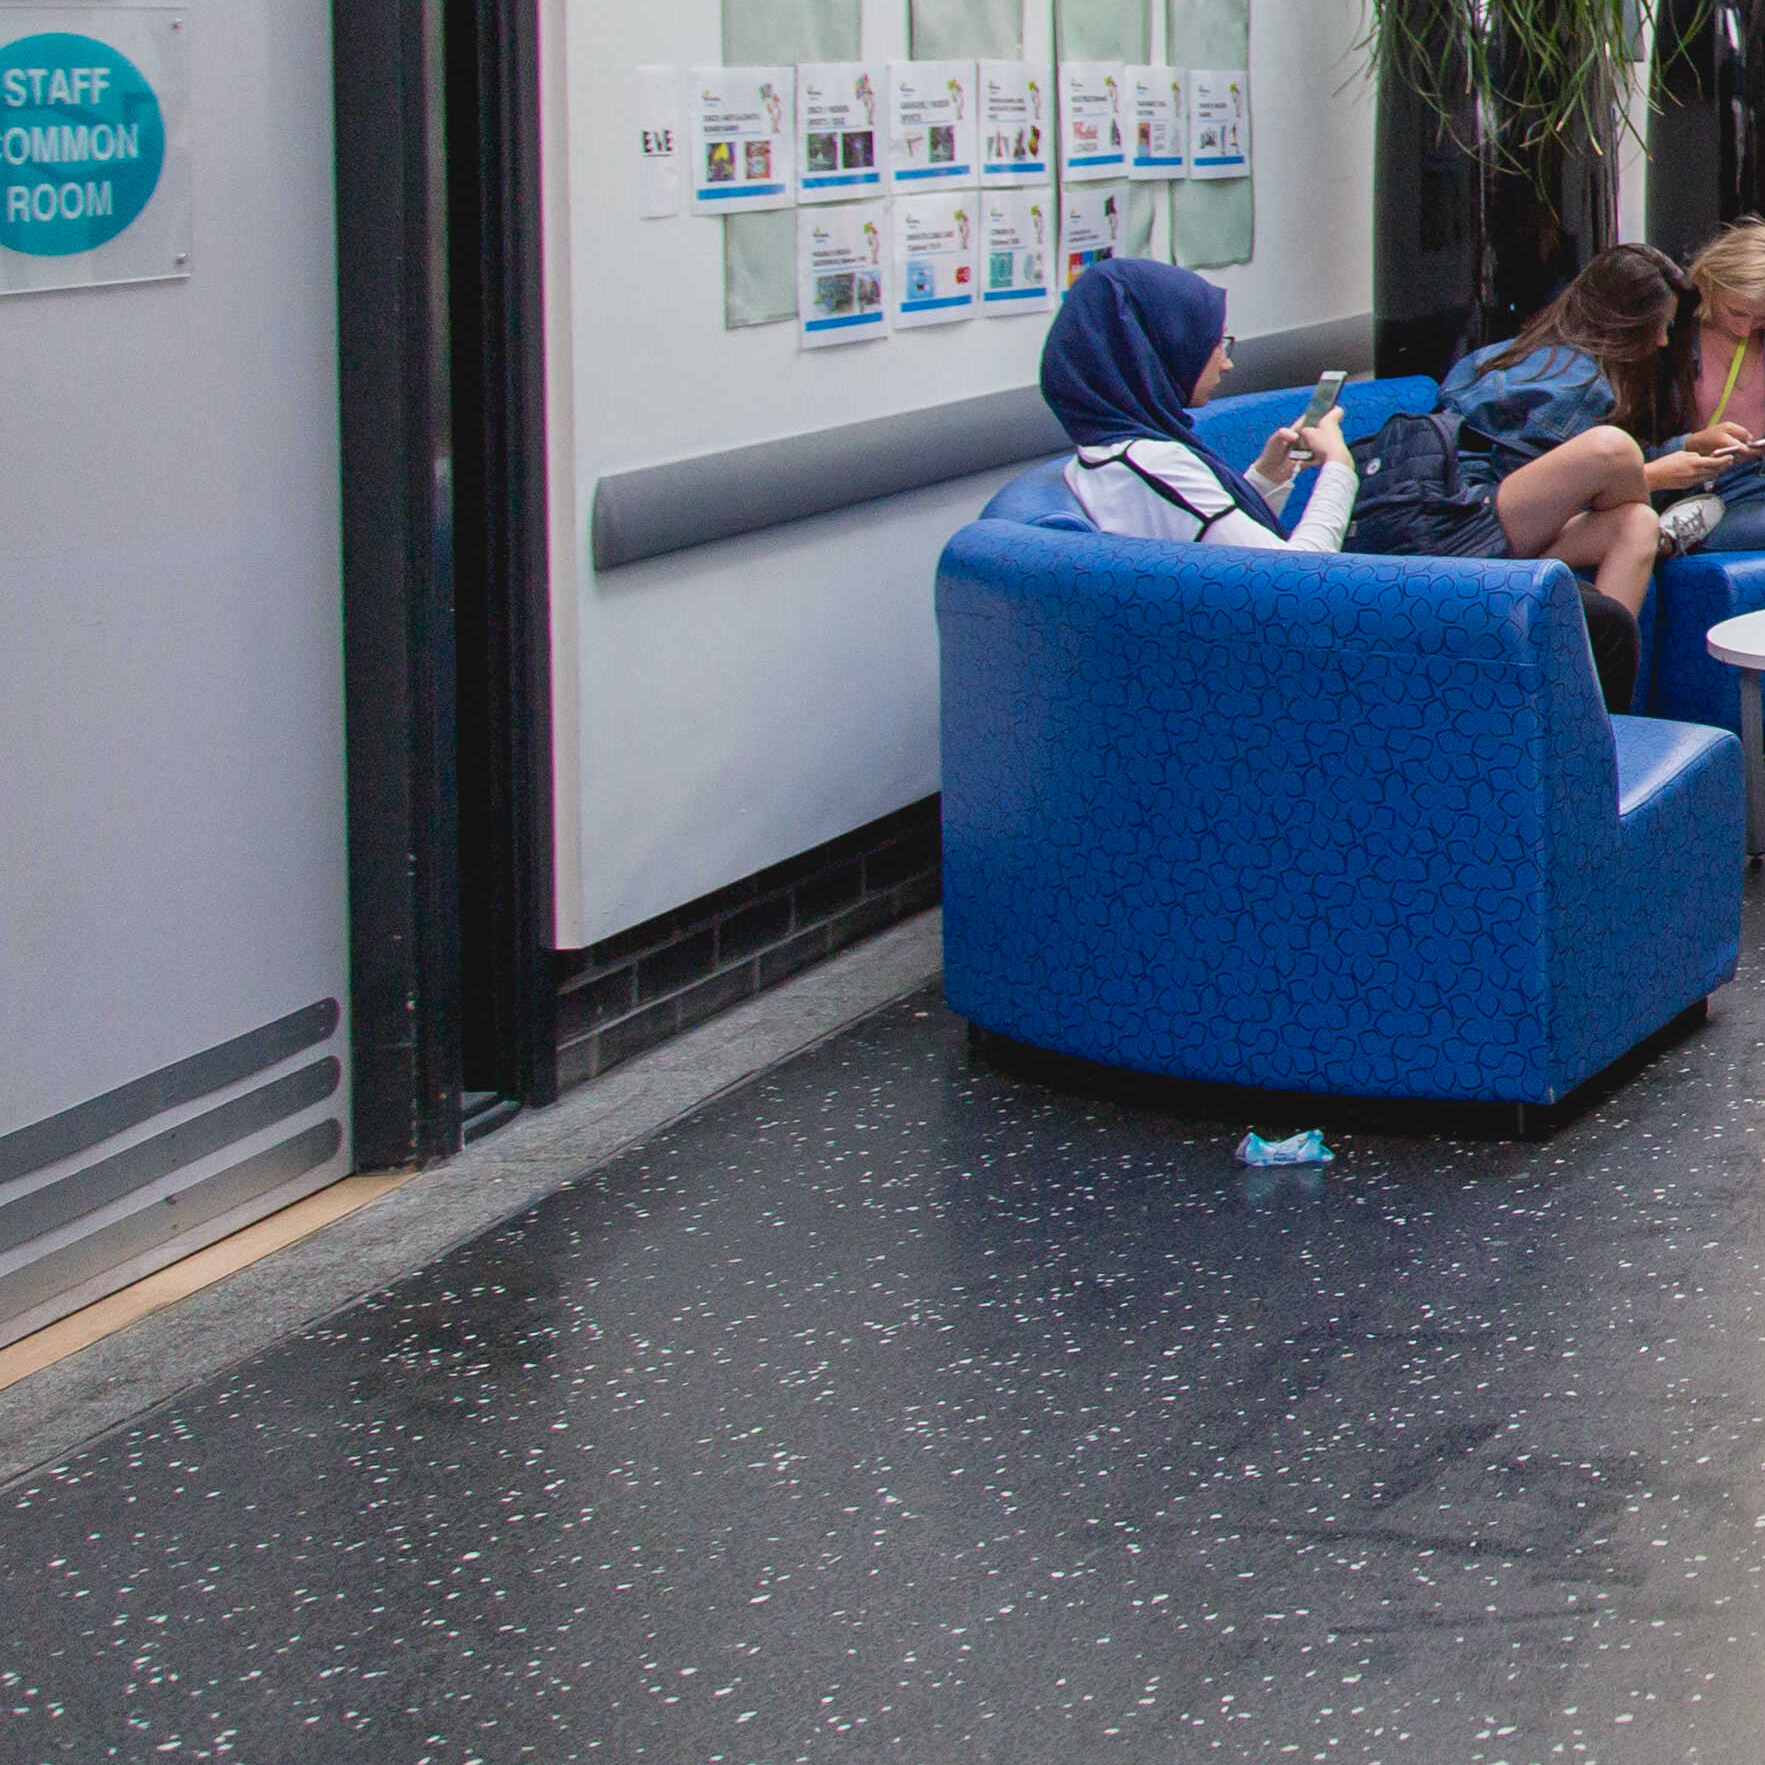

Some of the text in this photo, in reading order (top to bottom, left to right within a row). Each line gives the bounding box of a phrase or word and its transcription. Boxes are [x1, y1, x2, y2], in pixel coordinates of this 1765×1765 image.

[3, 67, 111, 107] STAFF
[0, 123, 139, 166] OMMON
[7, 180, 114, 223] ROOM
